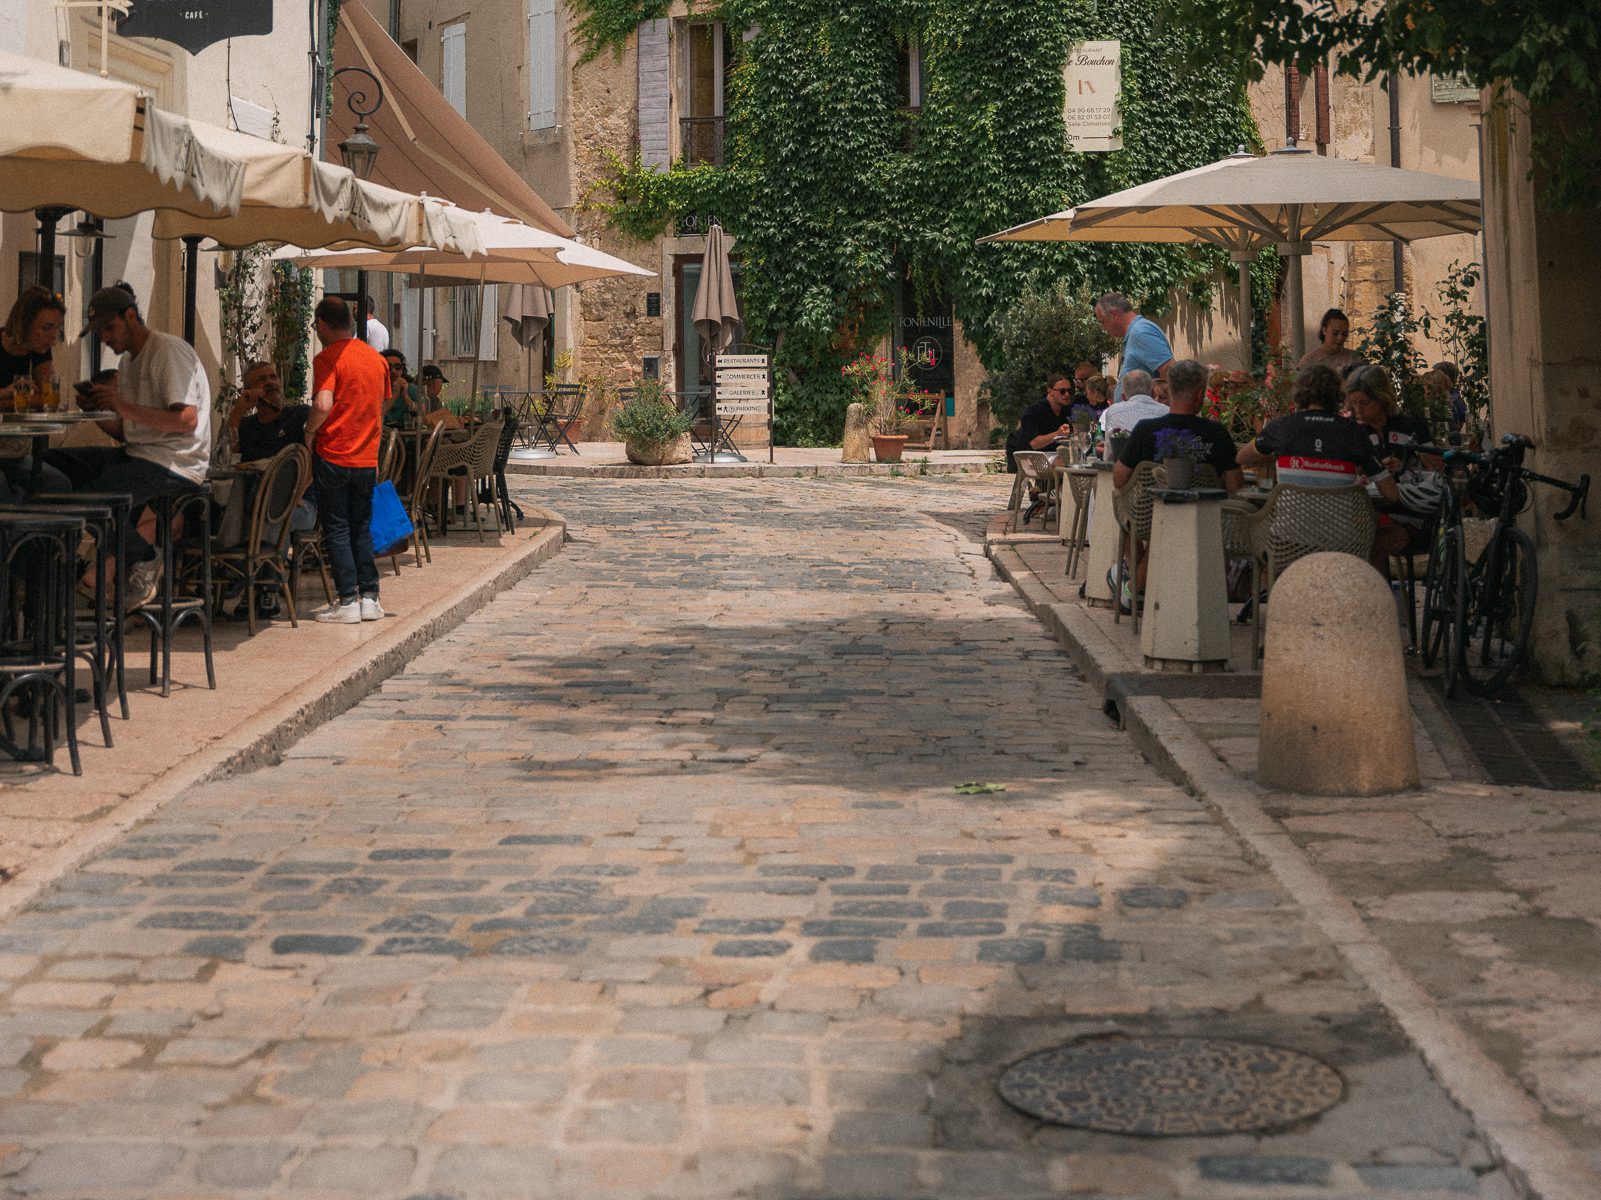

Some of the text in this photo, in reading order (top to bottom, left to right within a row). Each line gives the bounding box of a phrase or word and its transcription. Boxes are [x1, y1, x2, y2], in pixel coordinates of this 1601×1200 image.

[1075, 54, 1115, 66] Bouchon
[899, 315, 953, 329] FONTENILLE
[1303, 460, 1345, 472] RadioShack
